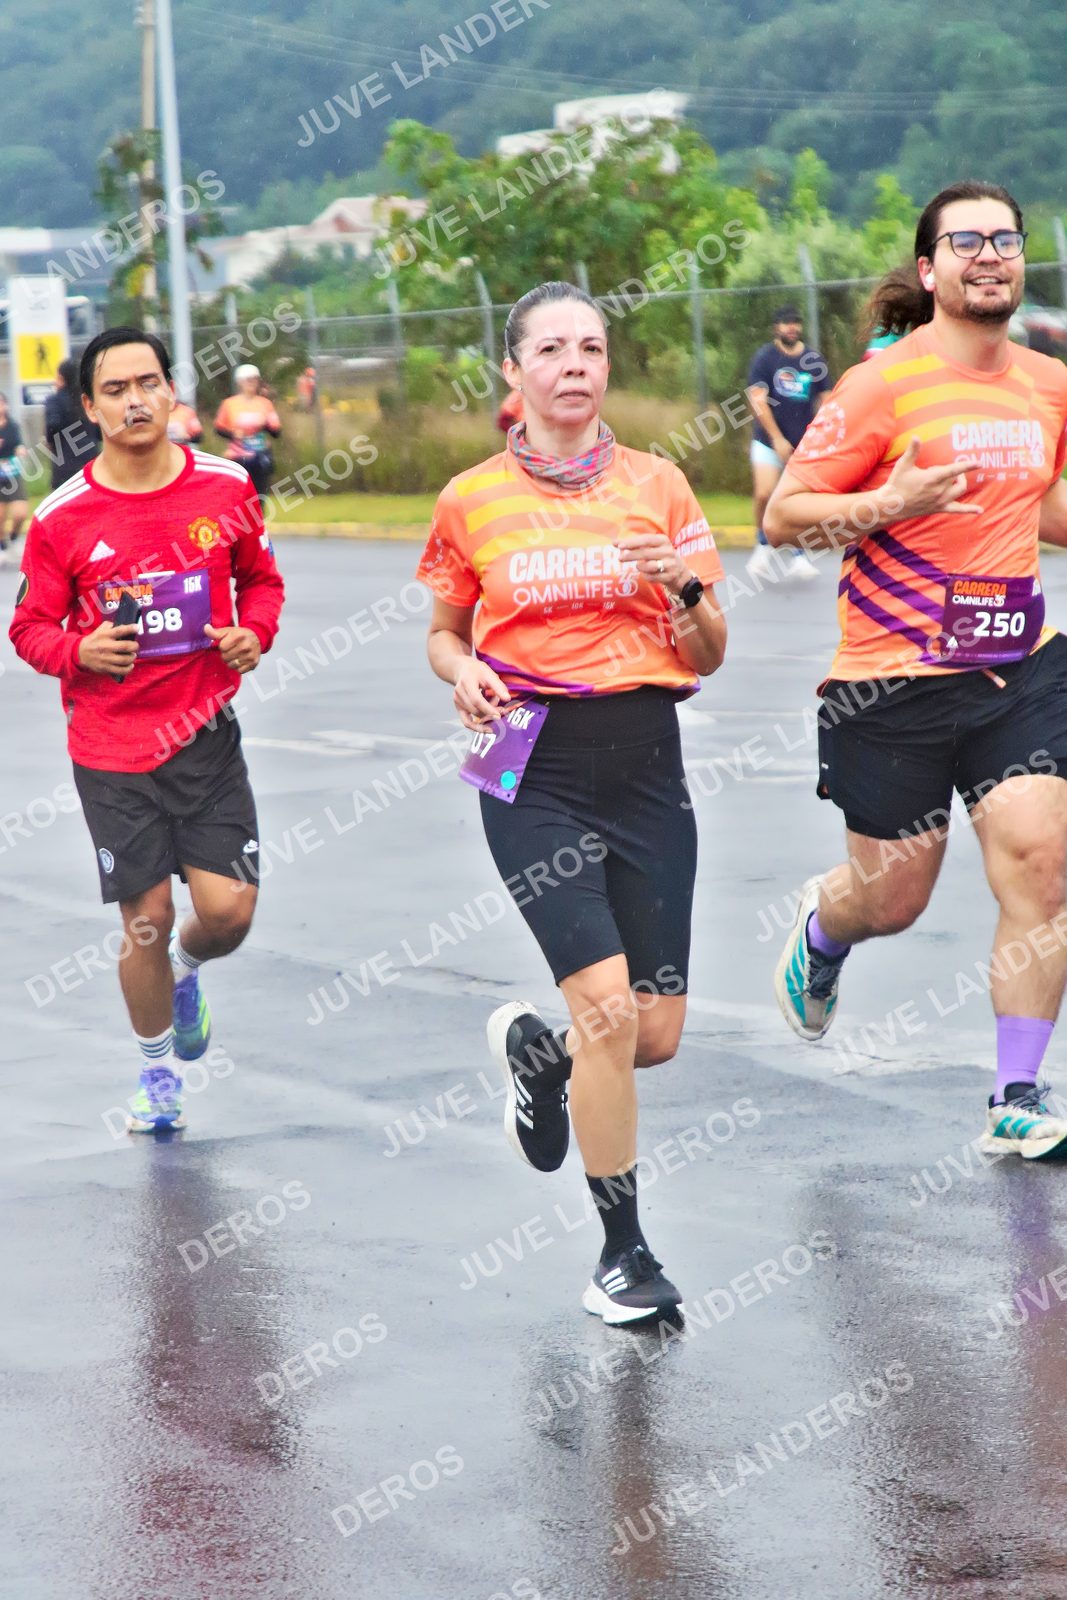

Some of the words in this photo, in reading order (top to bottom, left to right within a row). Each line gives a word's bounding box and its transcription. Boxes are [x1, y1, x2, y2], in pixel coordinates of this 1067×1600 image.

[951, 419, 1044, 451] CARRERA
[513, 579, 613, 607] OMNILIFE
[952, 595, 994, 607] OMNILIFE
[953, 580, 1007, 597] CARRERA
[973, 611, 1026, 638] 250
